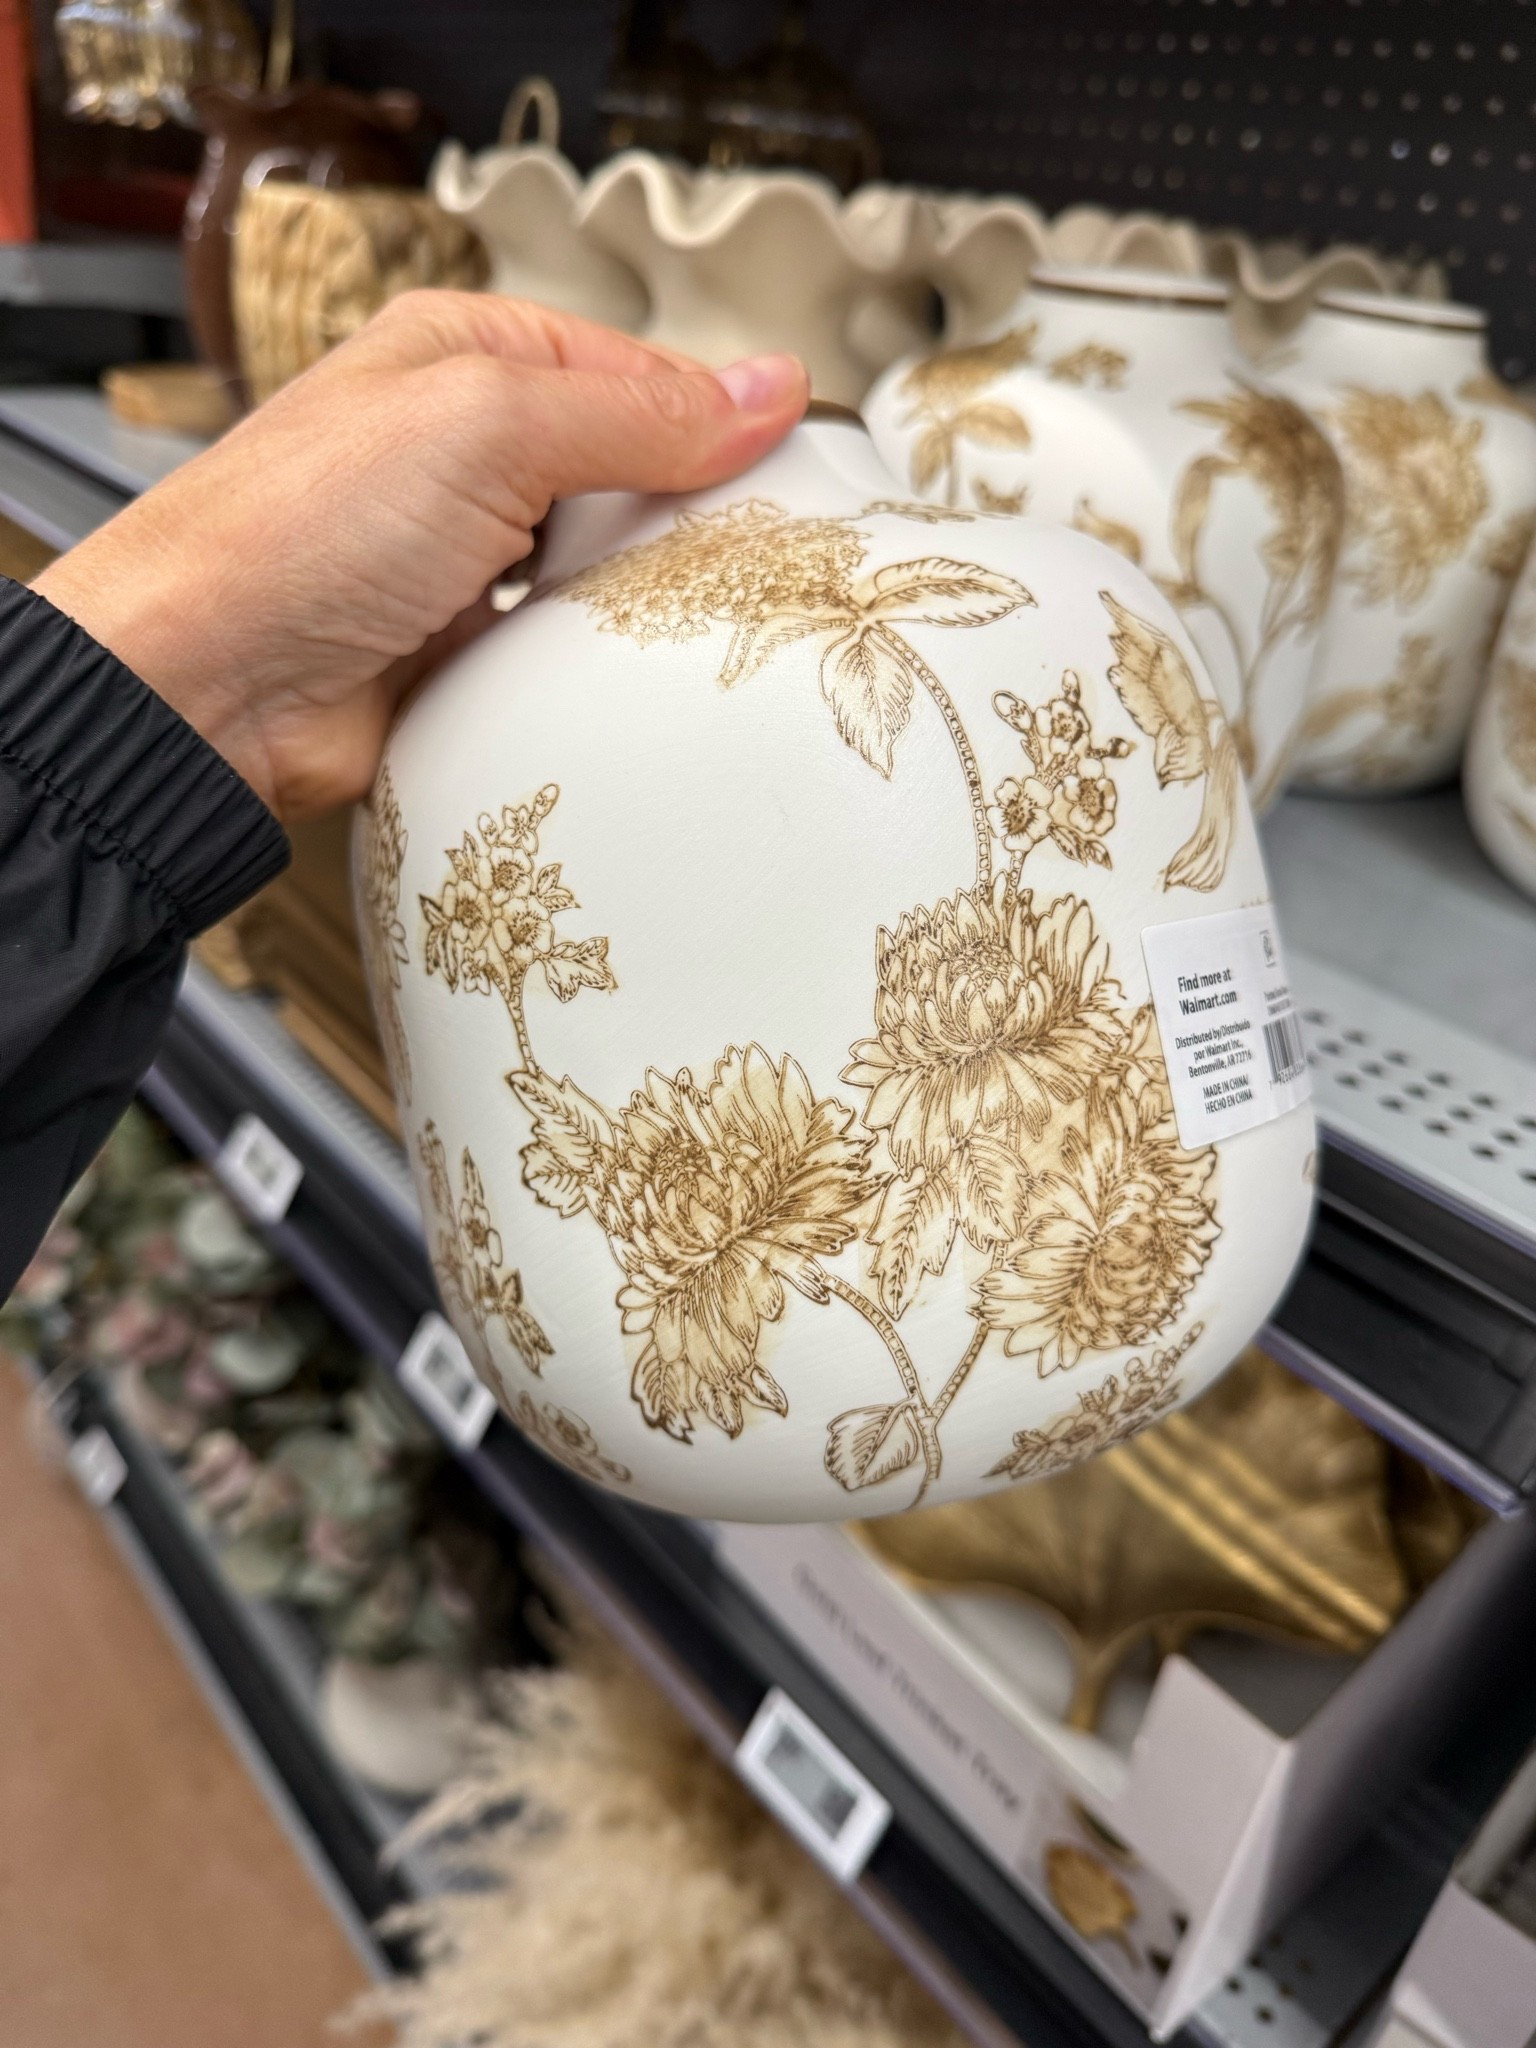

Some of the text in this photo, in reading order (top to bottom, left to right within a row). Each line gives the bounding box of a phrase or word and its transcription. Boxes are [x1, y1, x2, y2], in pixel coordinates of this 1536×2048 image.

[1177, 967, 1232, 993] Find more at
[1178, 990, 1237, 1016] Walmart.com
[1175, 1027, 1213, 1050] Distributed
[1193, 1049, 1205, 1064] por
[1204, 1040, 1231, 1058] Walmart
[1188, 1057, 1227, 1079] Bentonville,
[1202, 1082, 1222, 1100] MADE
[1221, 1079, 1230, 1093] IN
[1204, 1088, 1253, 1114] HECHO EN CHINA
